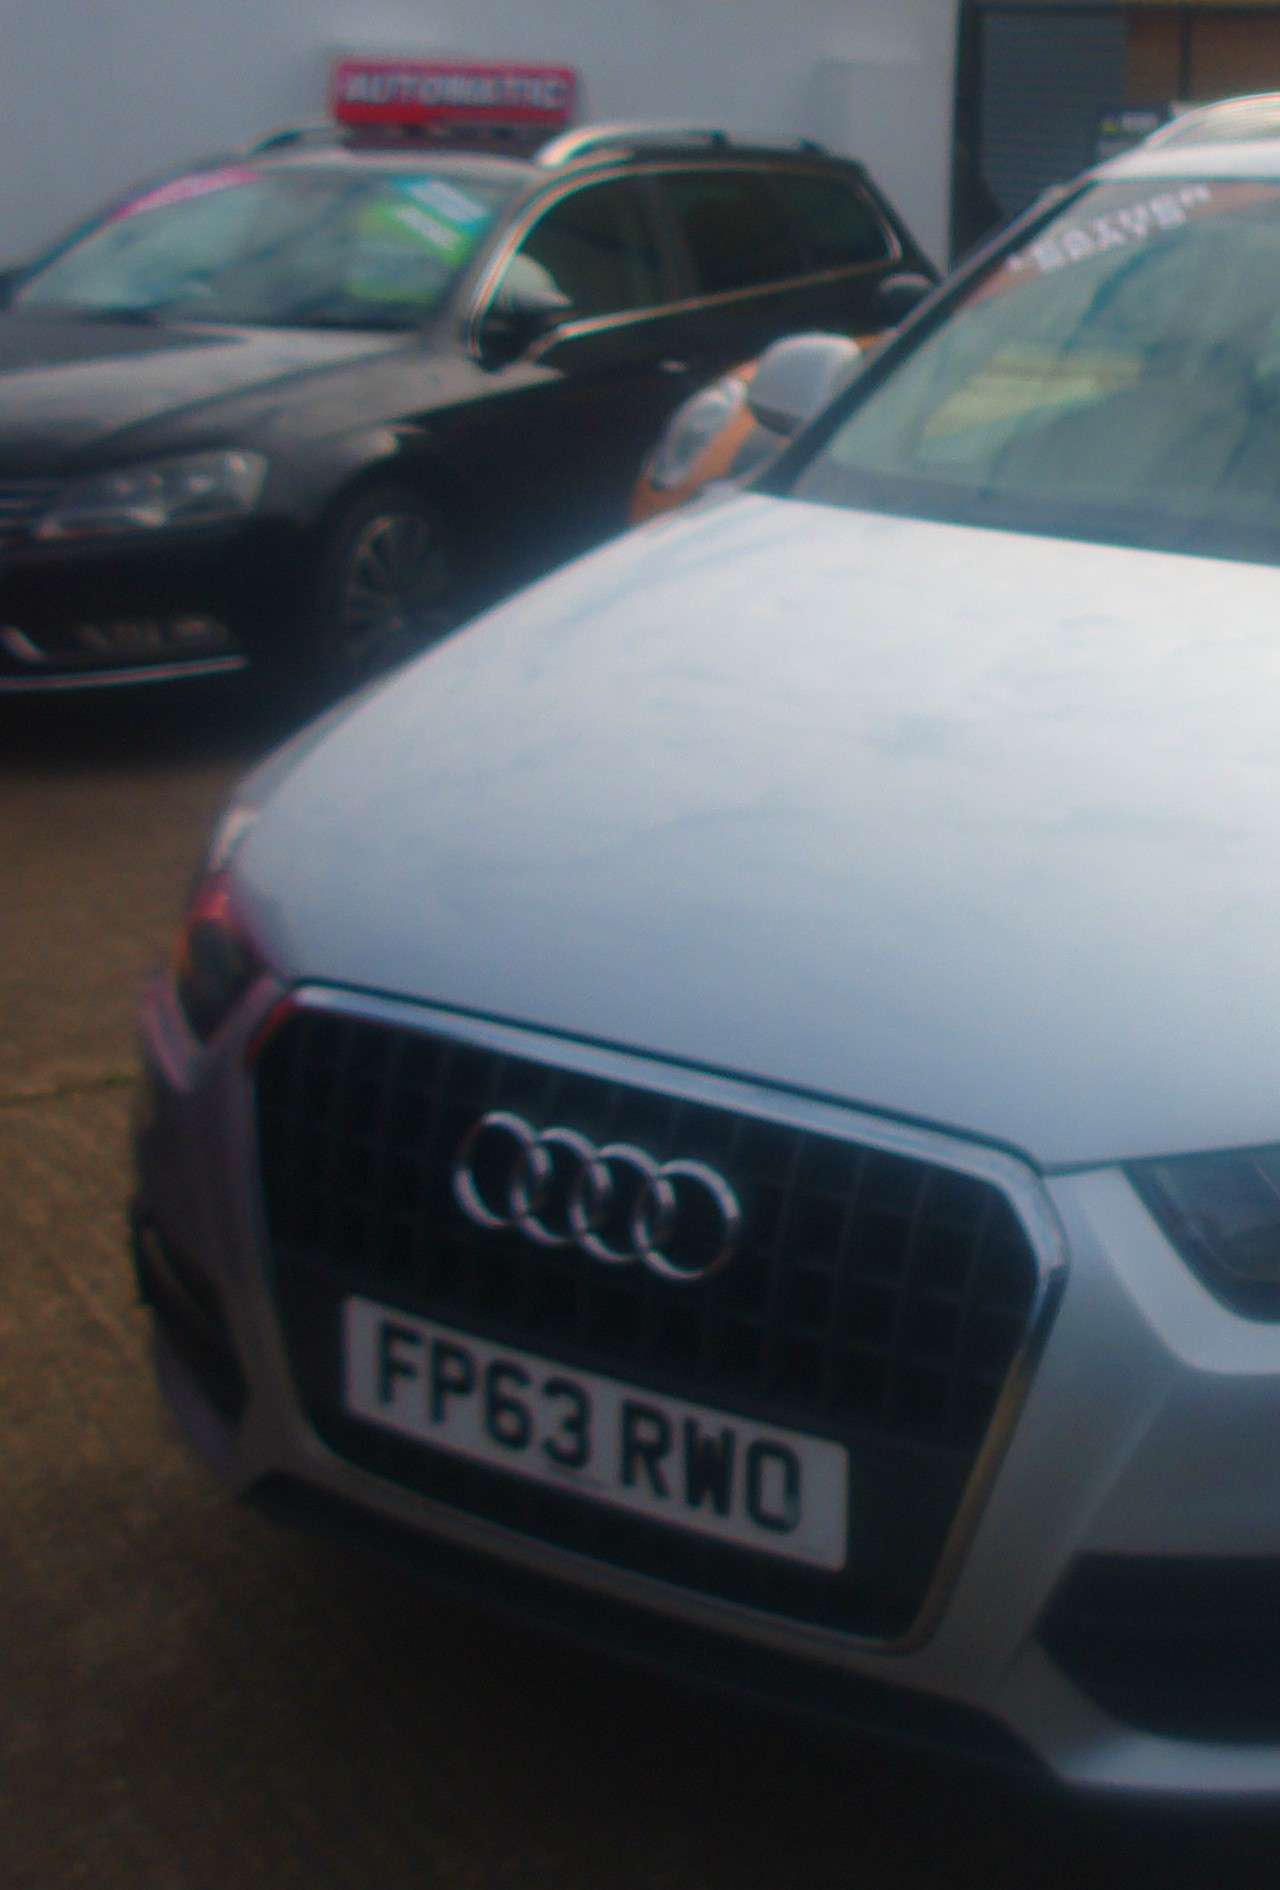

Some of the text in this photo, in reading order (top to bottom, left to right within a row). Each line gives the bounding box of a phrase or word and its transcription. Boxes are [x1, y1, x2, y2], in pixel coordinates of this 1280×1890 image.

[347, 72, 568, 110] AUTOMATIC
[376, 1321, 803, 1535] FP63 RWO
